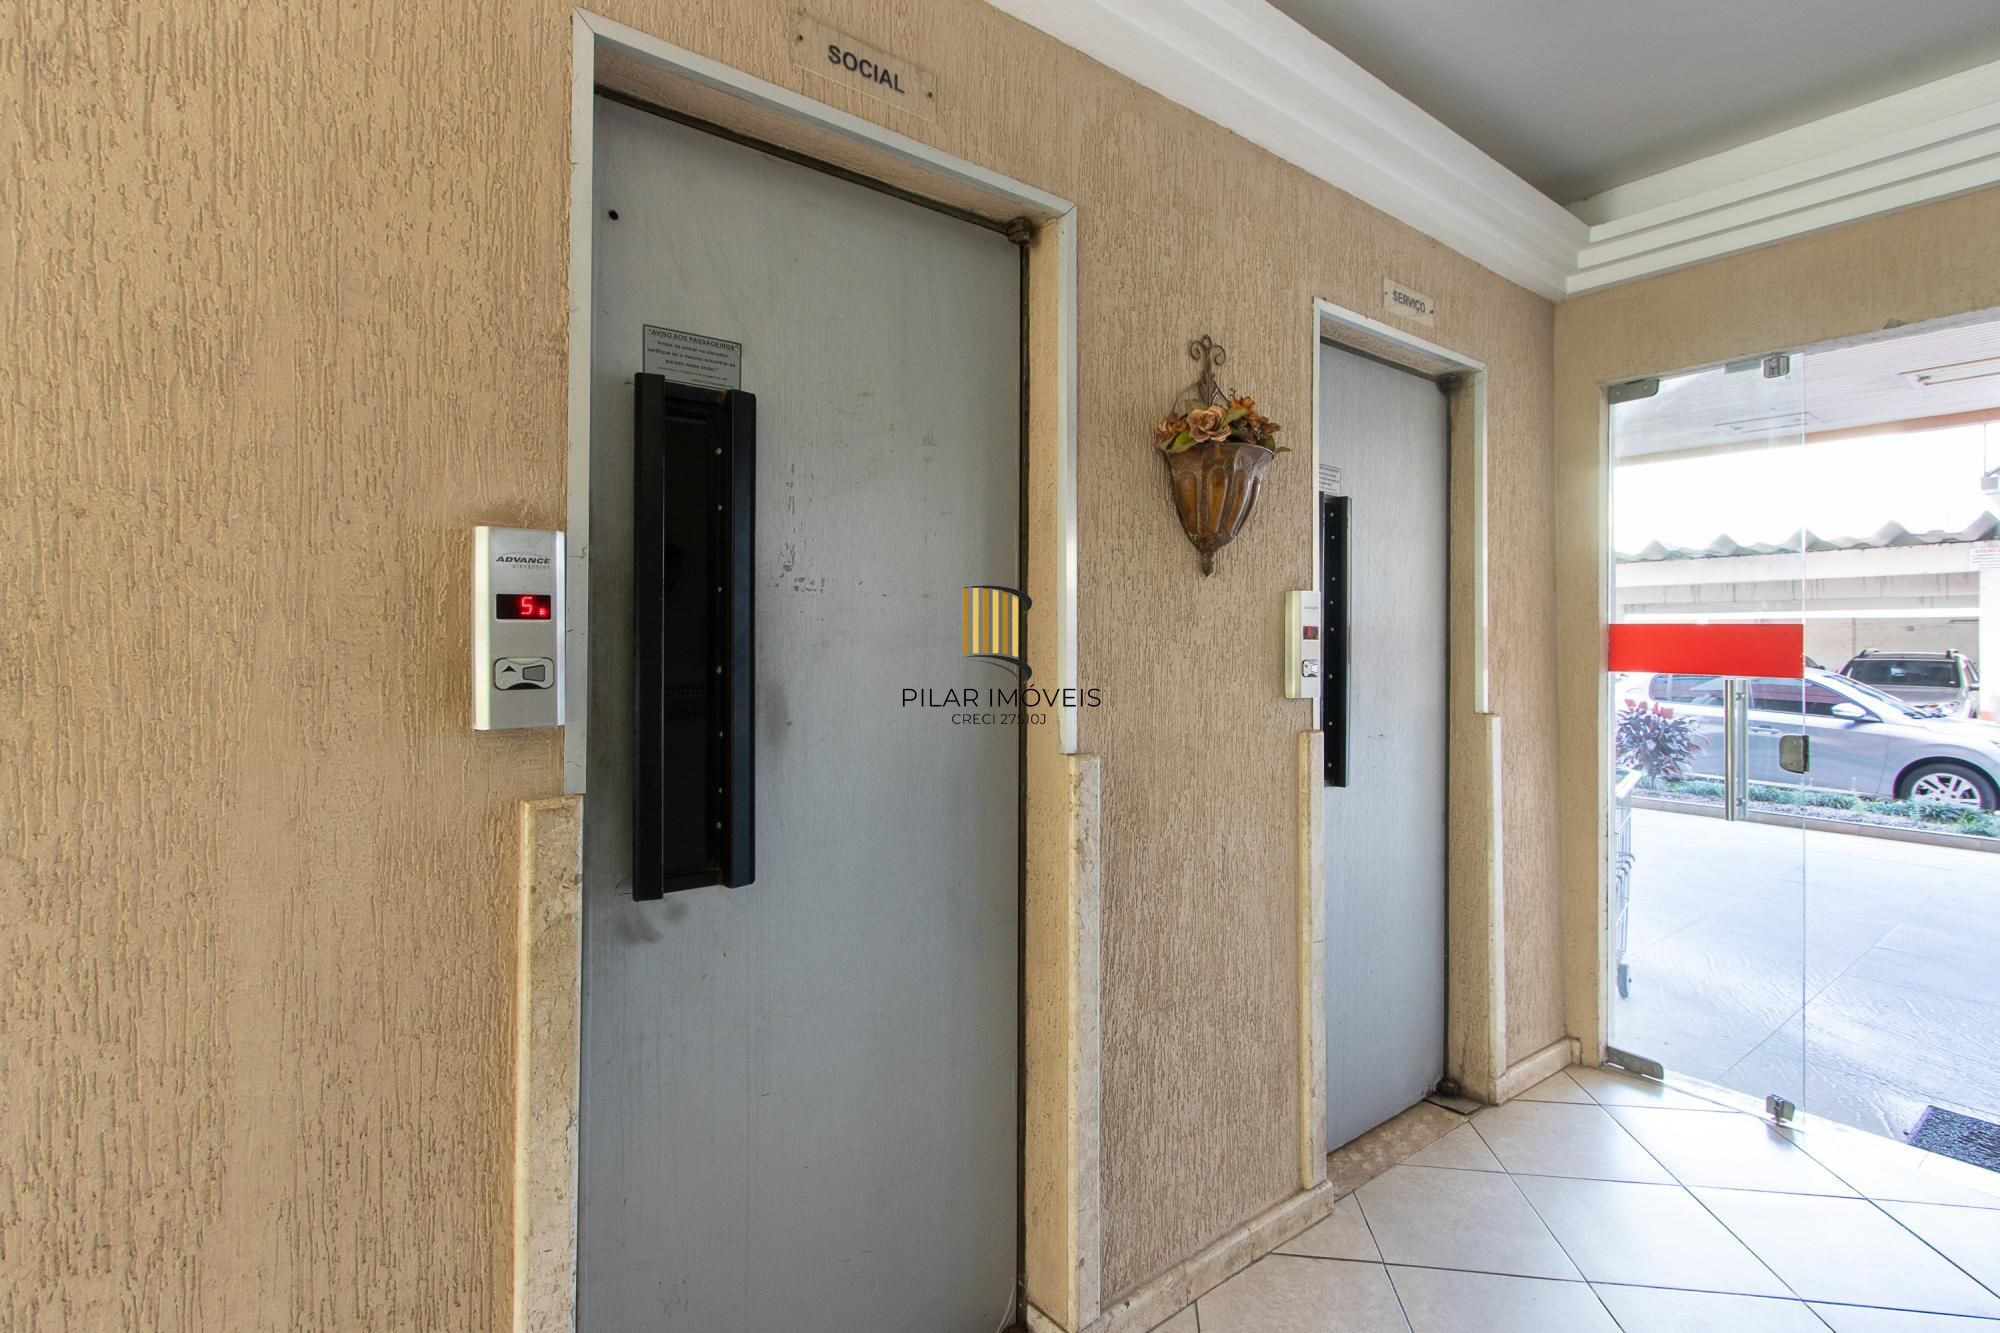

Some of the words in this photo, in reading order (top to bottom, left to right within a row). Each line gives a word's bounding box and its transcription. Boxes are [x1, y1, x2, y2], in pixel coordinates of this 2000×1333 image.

[828, 44, 906, 94] SOCIAL
[1392, 289, 1426, 314] SERVIÇO
[673, 333, 687, 342] AOS
[495, 556, 551, 564] ADVANCE
[520, 596, 533, 615] 5
